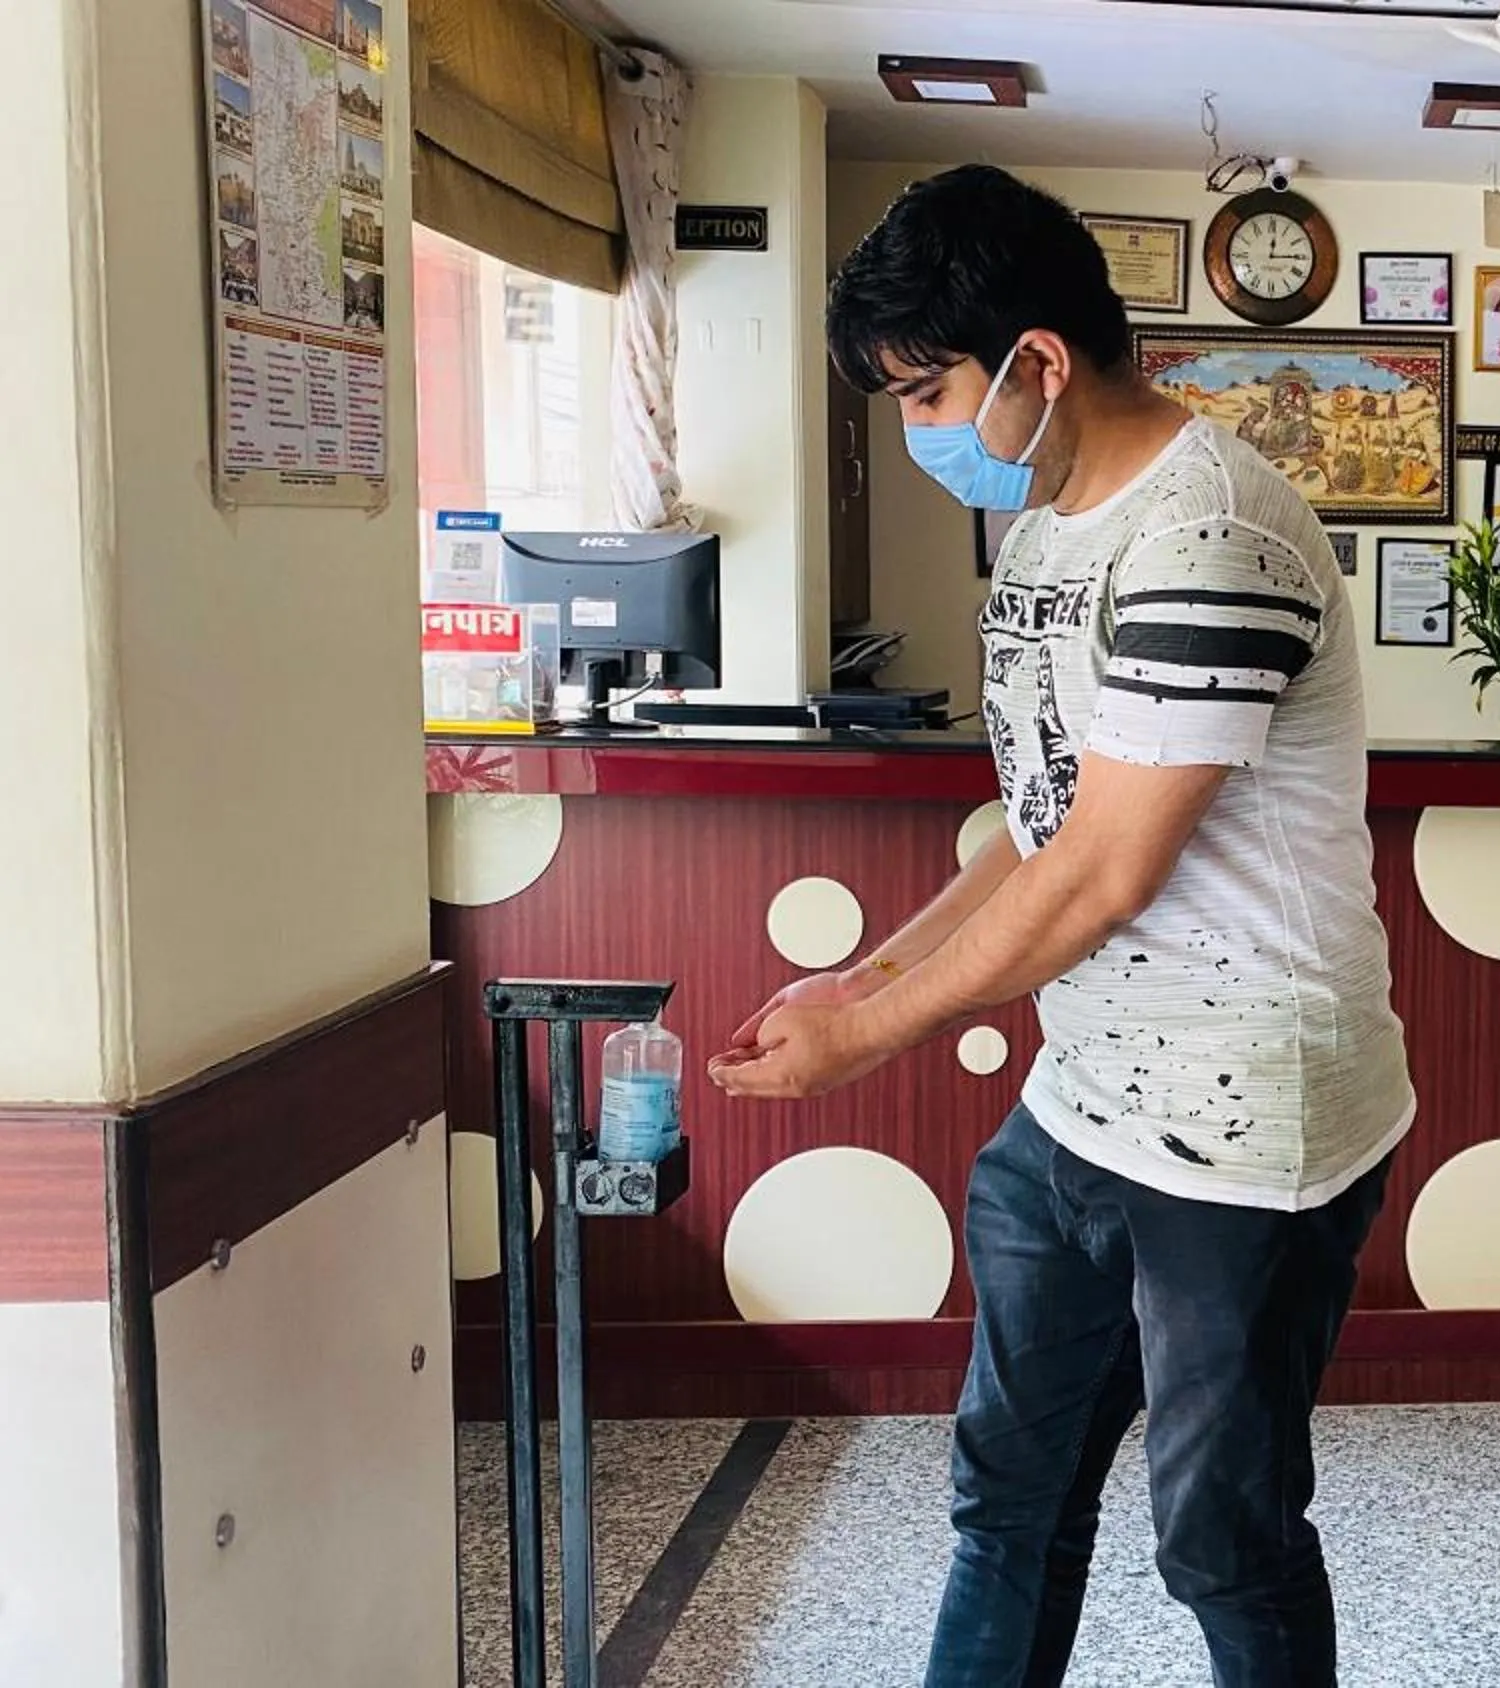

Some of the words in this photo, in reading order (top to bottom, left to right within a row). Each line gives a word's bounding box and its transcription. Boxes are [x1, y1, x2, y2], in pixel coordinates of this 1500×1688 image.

[685, 218, 760, 239] EPTION
[1485, 434, 1497, 452] OF
[579, 537, 630, 548] HCL
[421, 608, 514, 637] ानपात्र
